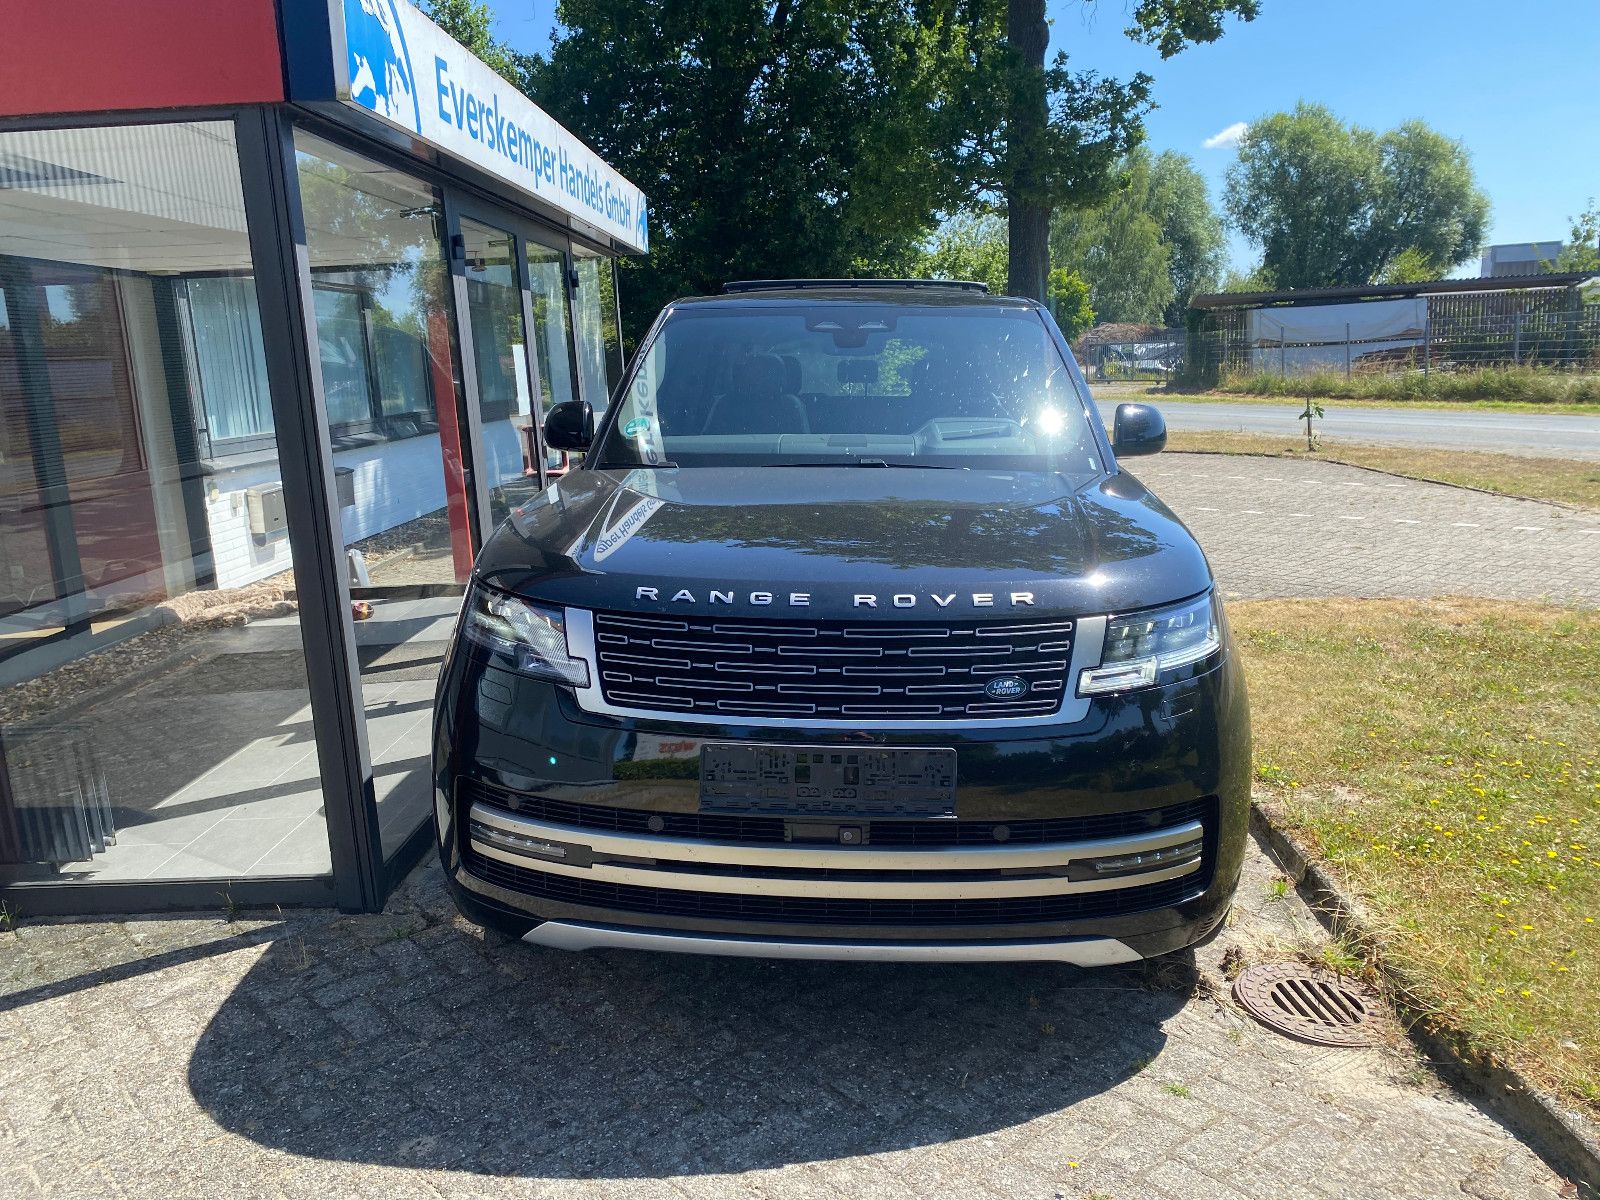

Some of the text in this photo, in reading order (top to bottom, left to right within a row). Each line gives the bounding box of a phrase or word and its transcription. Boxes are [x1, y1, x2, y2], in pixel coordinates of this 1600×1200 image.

[434, 54, 632, 231] Everskemper Handels GmbH
[635, 586, 1035, 608] RANGE ROVER
[995, 687, 1021, 695] ROVER
